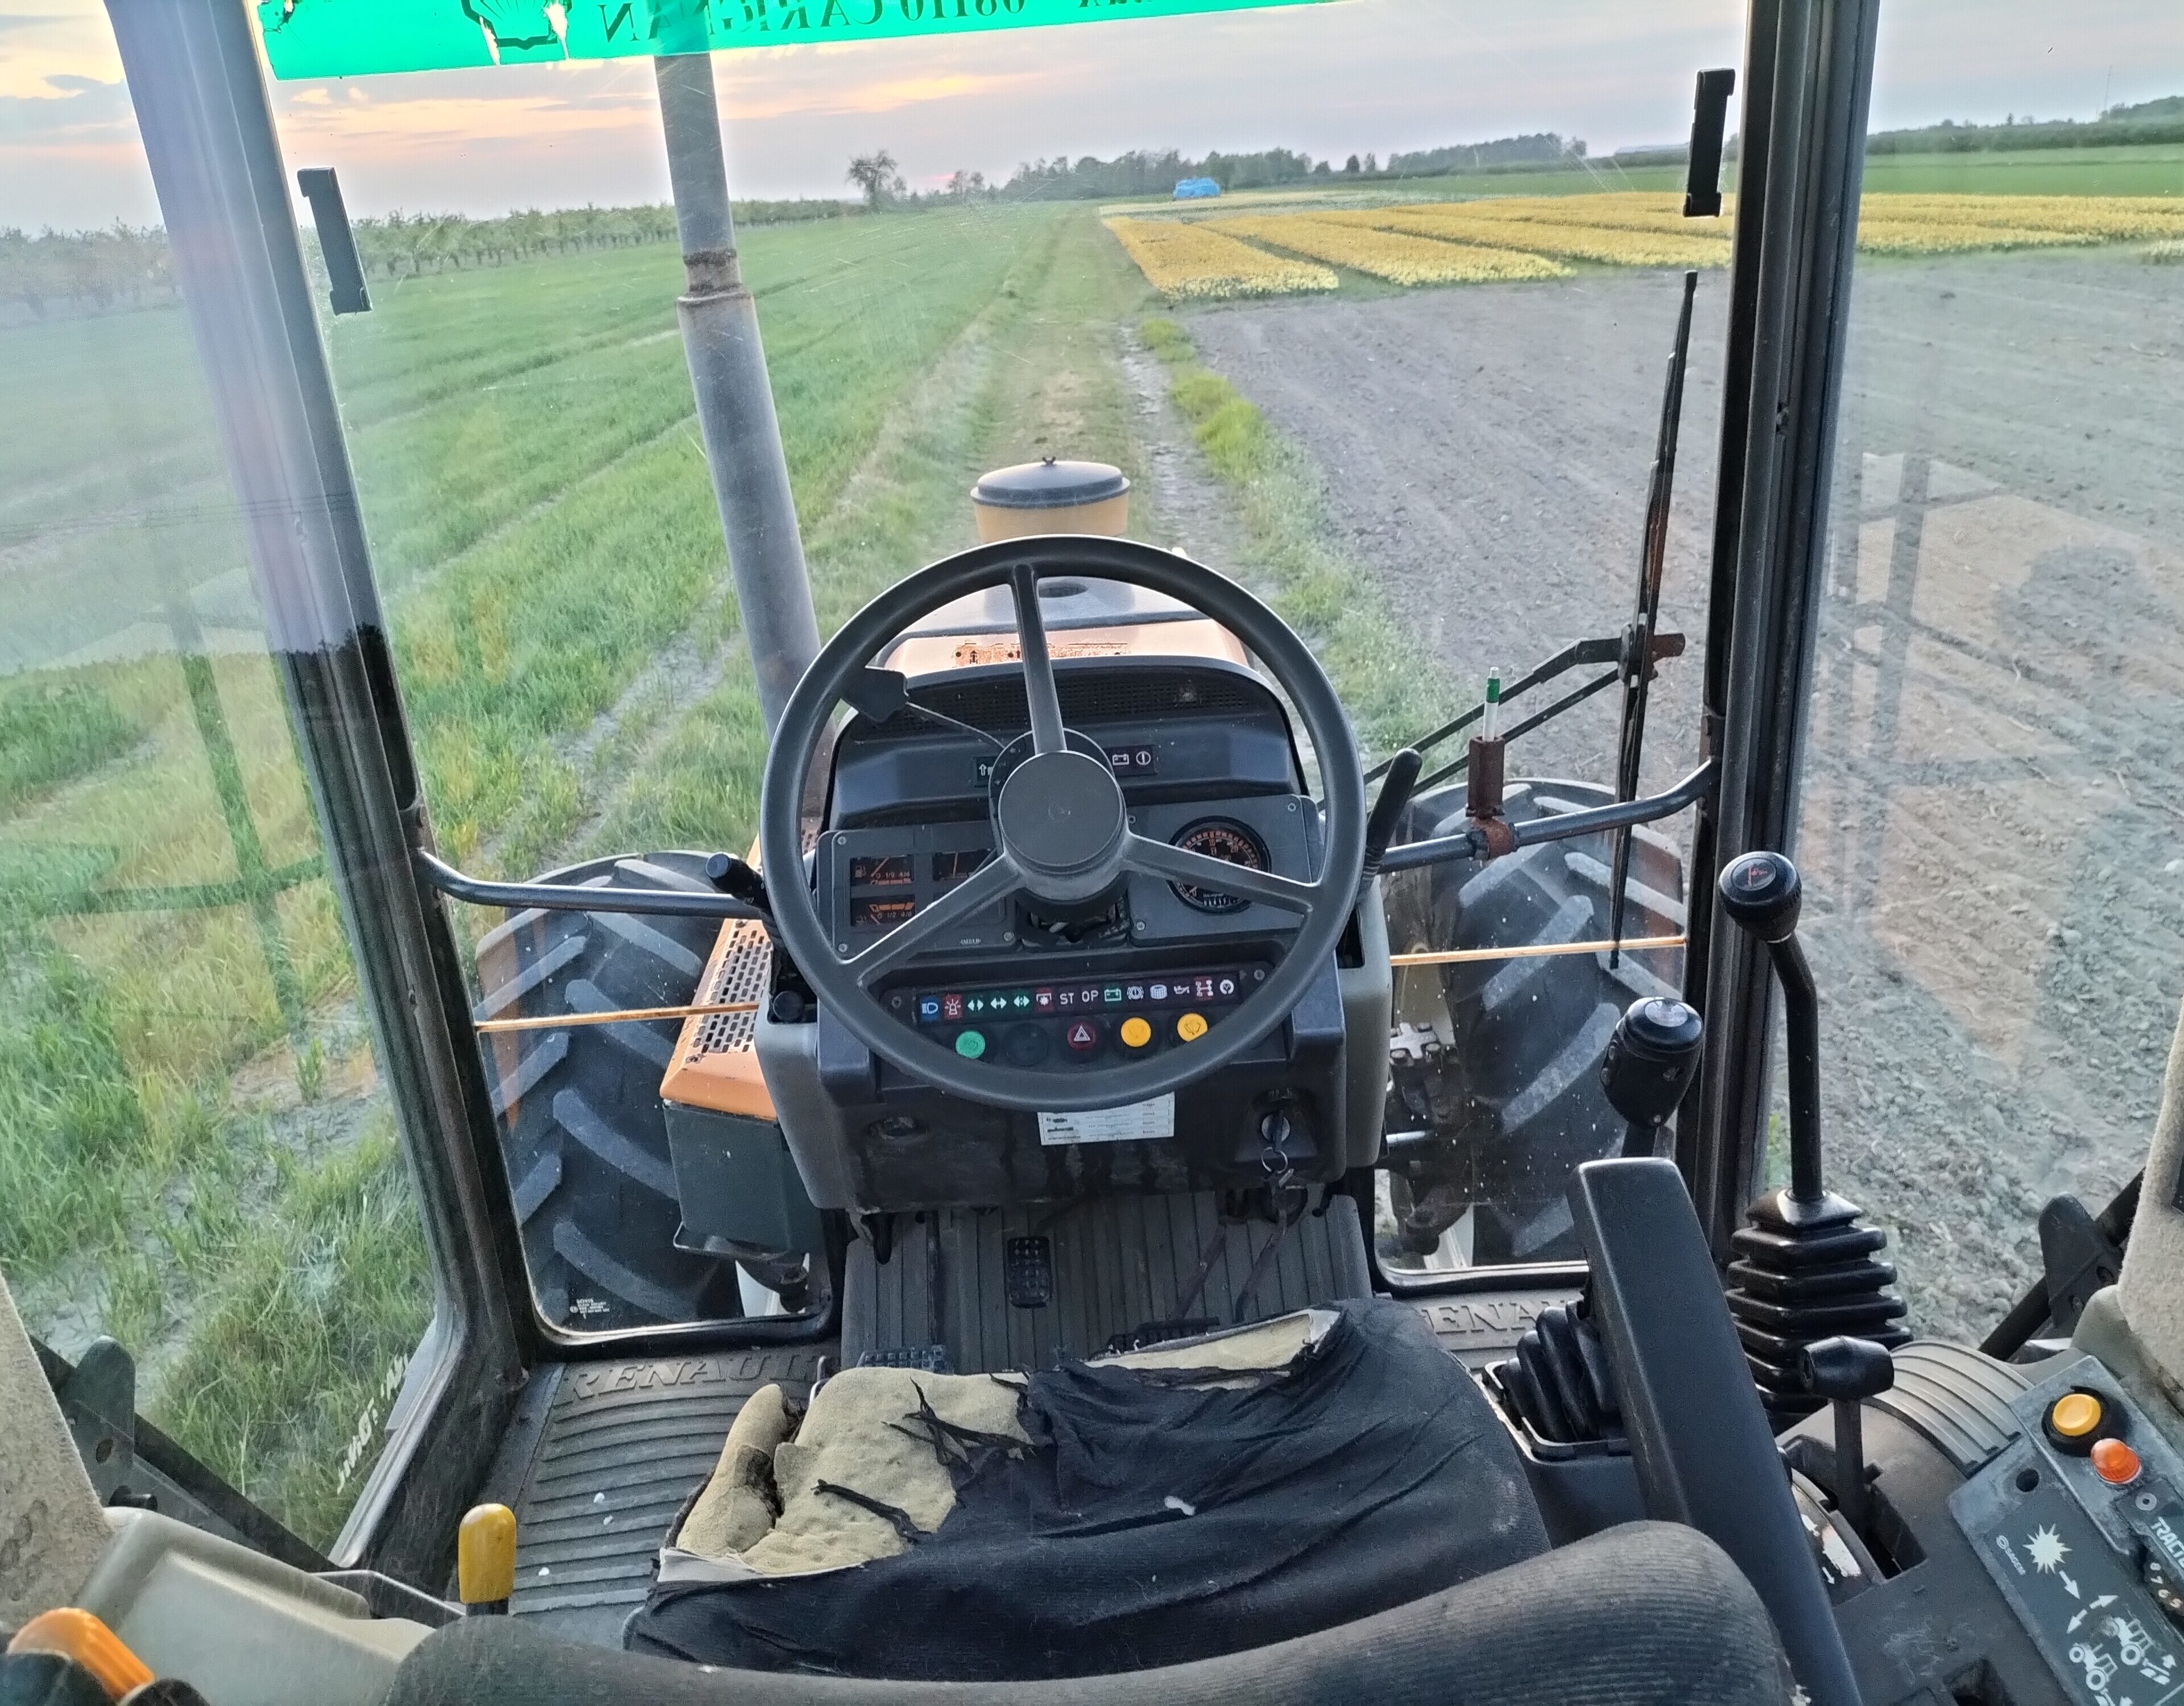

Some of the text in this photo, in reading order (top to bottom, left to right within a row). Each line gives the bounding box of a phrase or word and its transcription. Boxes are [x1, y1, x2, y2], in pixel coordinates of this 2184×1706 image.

[1060, 989, 1099, 1005] ST OP
[1422, 1299, 1567, 1335] ENA
[2150, 1516, 2184, 1569] TRACT
[2150, 1562, 2161, 1571] 8
